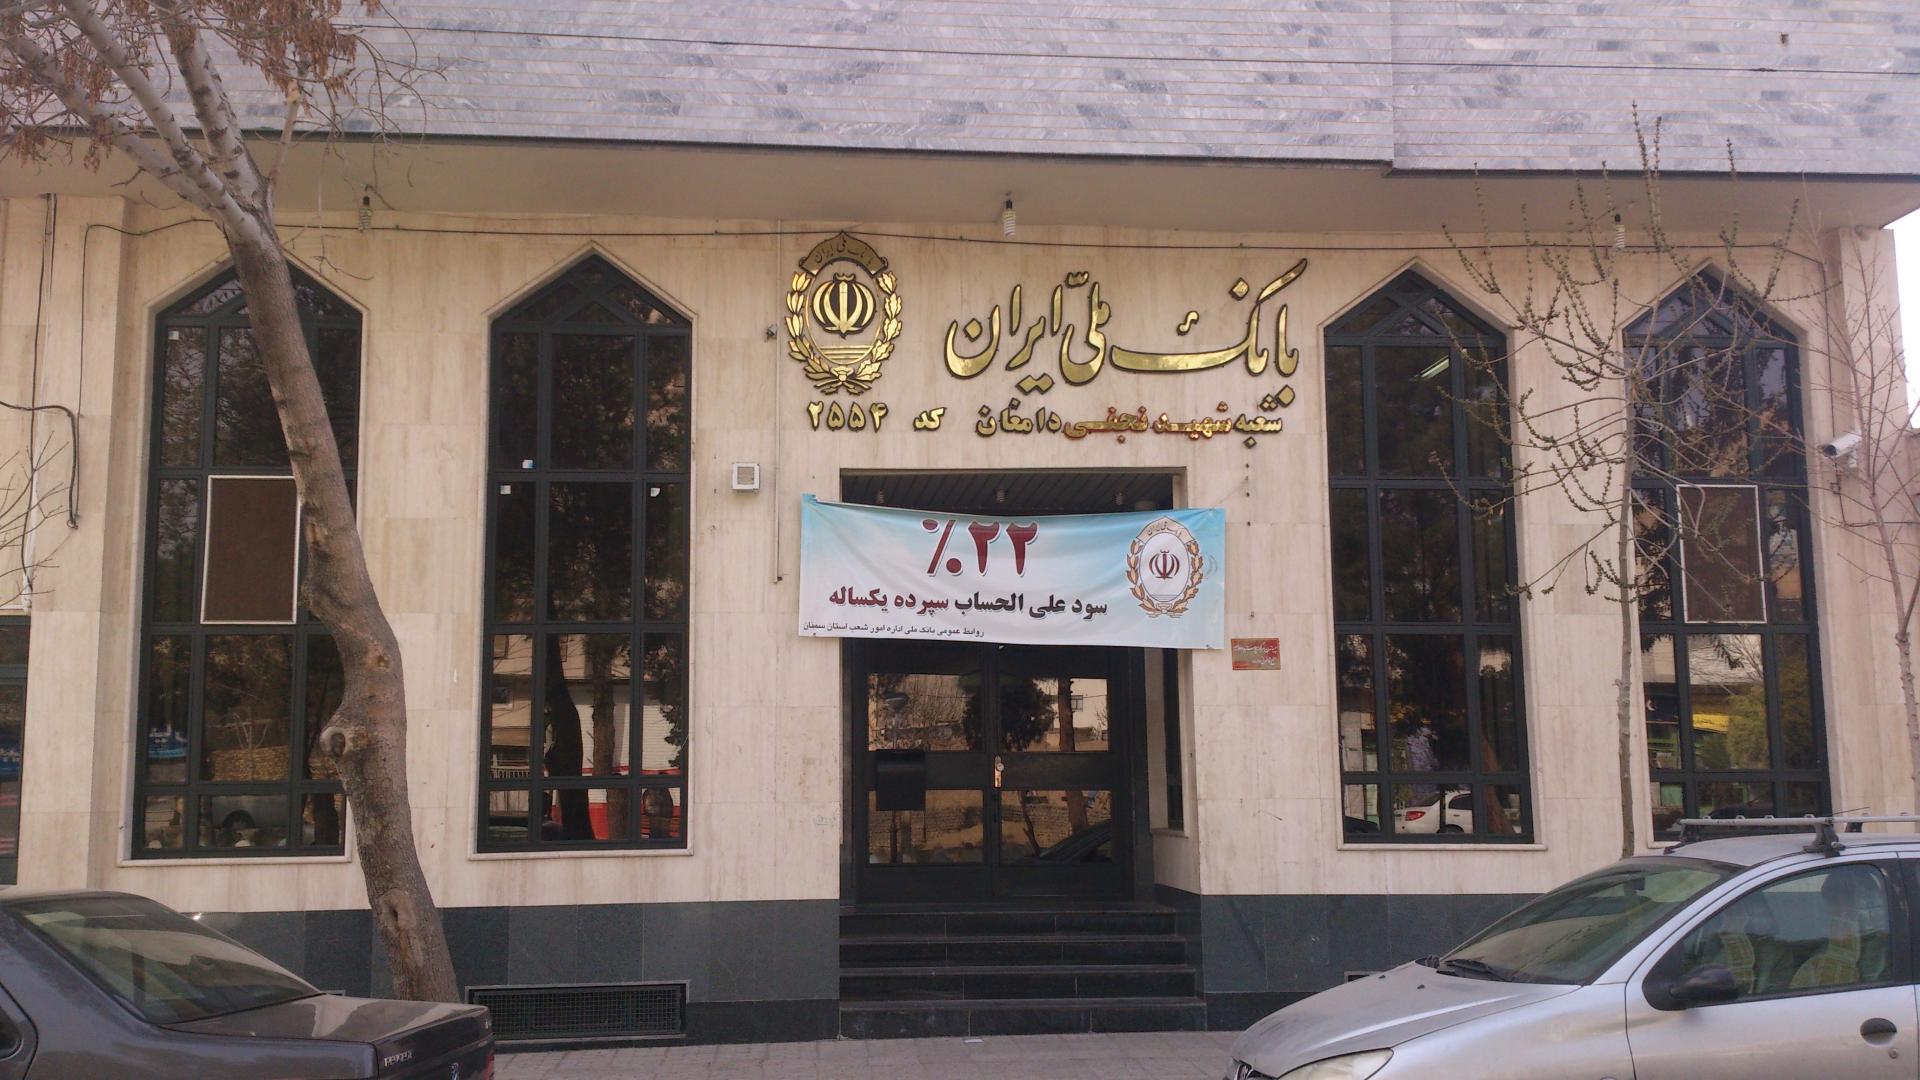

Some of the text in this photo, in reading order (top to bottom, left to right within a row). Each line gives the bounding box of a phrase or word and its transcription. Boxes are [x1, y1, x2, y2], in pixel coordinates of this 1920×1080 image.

[943, 283, 1063, 395] ایران
[1109, 258, 1308, 407] بانک
[806, 393, 1284, 449] شعبه شهید نجفی دامغان کد ۲۵۵۴
[803, 620, 985, 638] روابط عمومی بانک ملی اداره امور شعب استان سمنان
[828, 586, 1108, 620] سود علی الحساب سپرده یکساله
